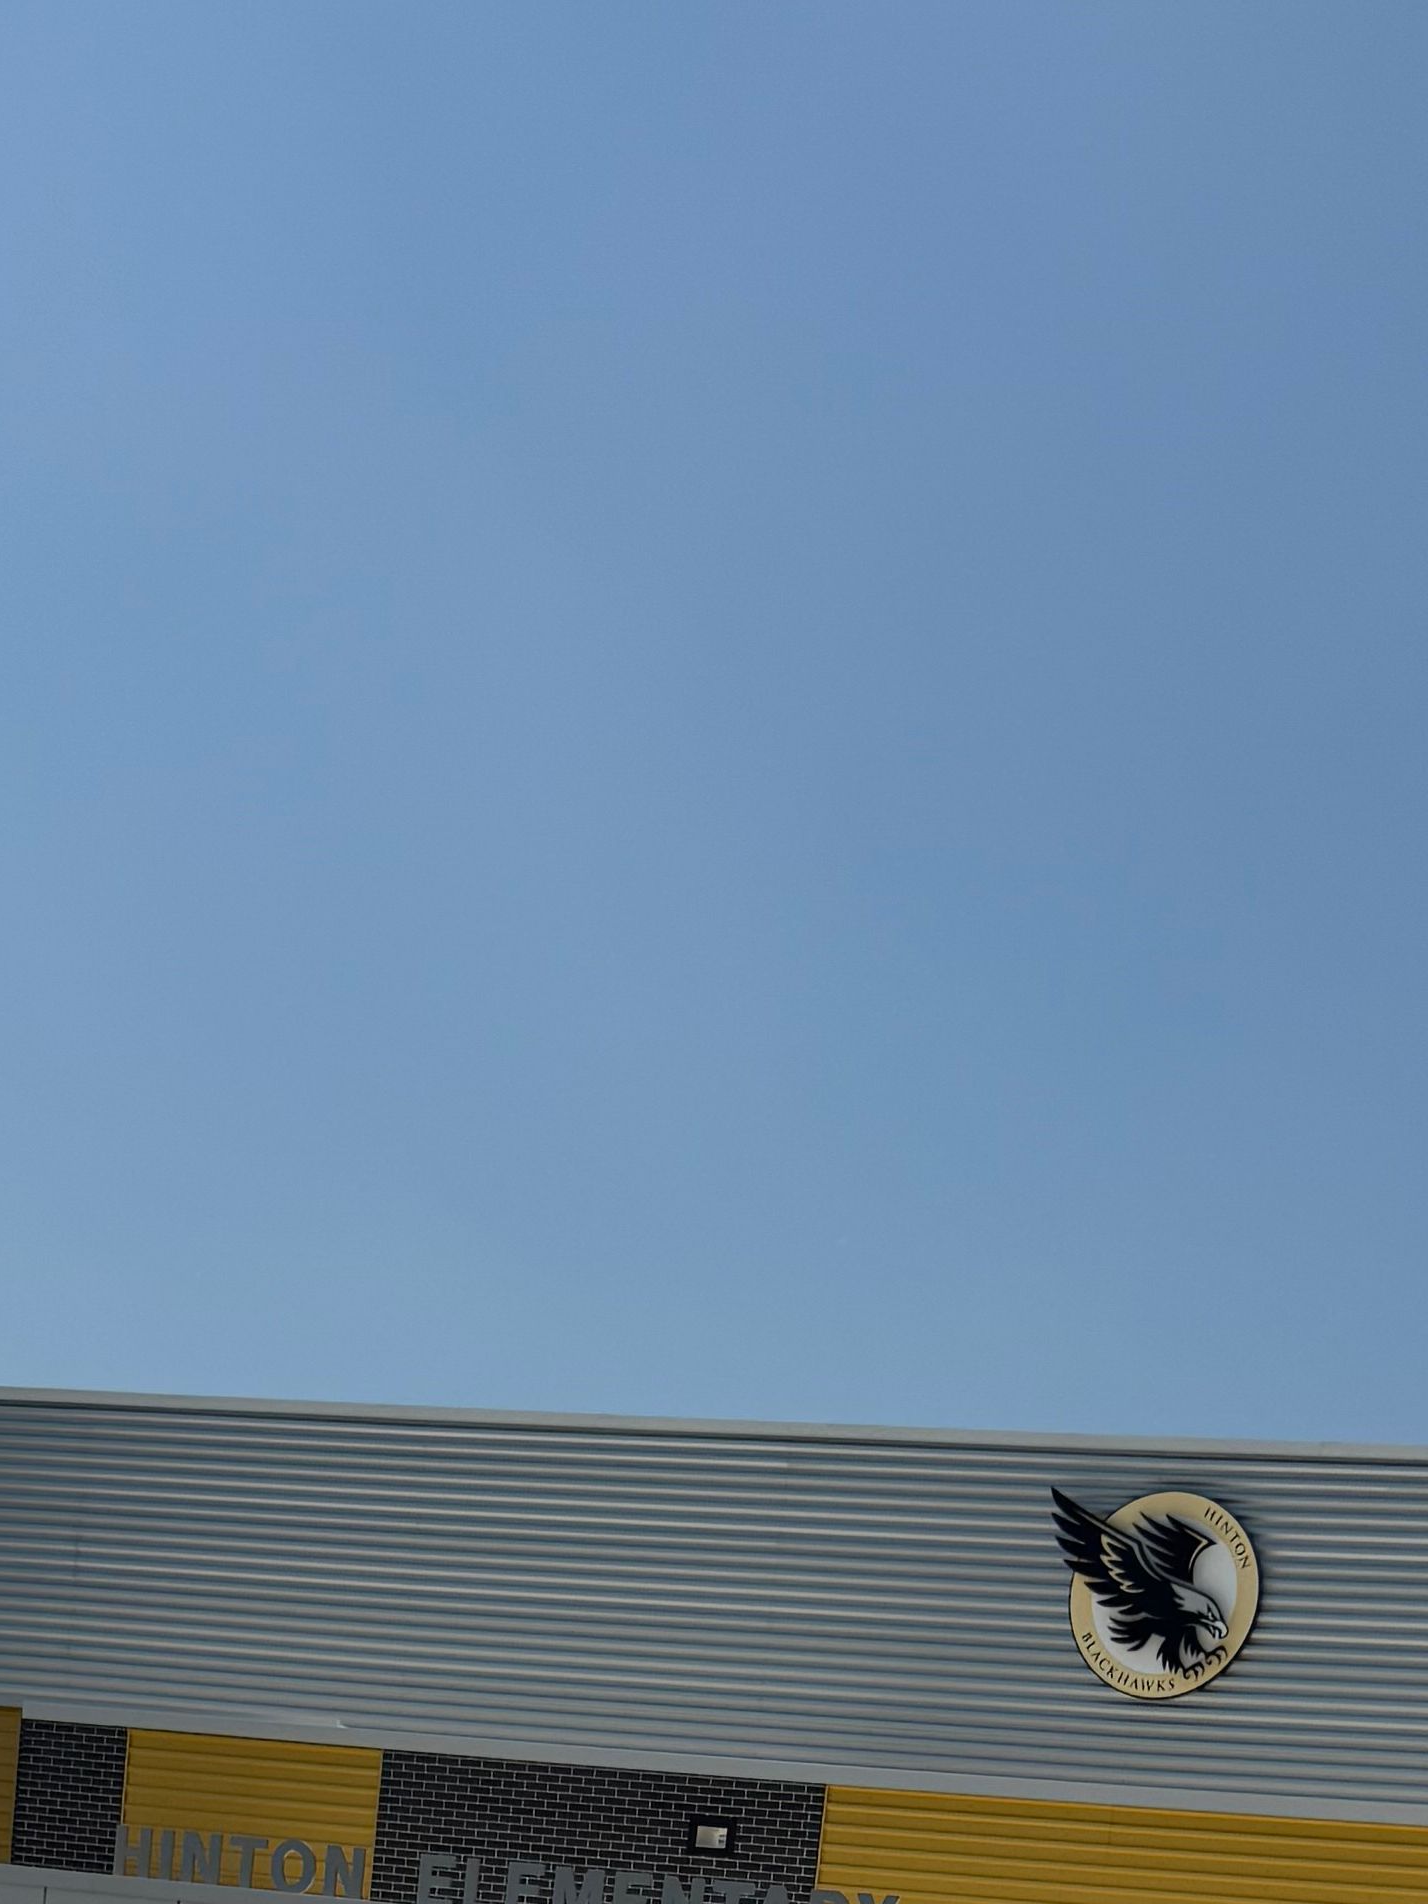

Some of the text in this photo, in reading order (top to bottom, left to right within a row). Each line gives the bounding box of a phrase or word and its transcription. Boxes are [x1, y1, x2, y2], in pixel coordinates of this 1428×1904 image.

[1204, 1506, 1252, 1570] HINTON
[1081, 1631, 1176, 1692] BLACKHAWKS
[113, 1824, 368, 1900] HINTON
